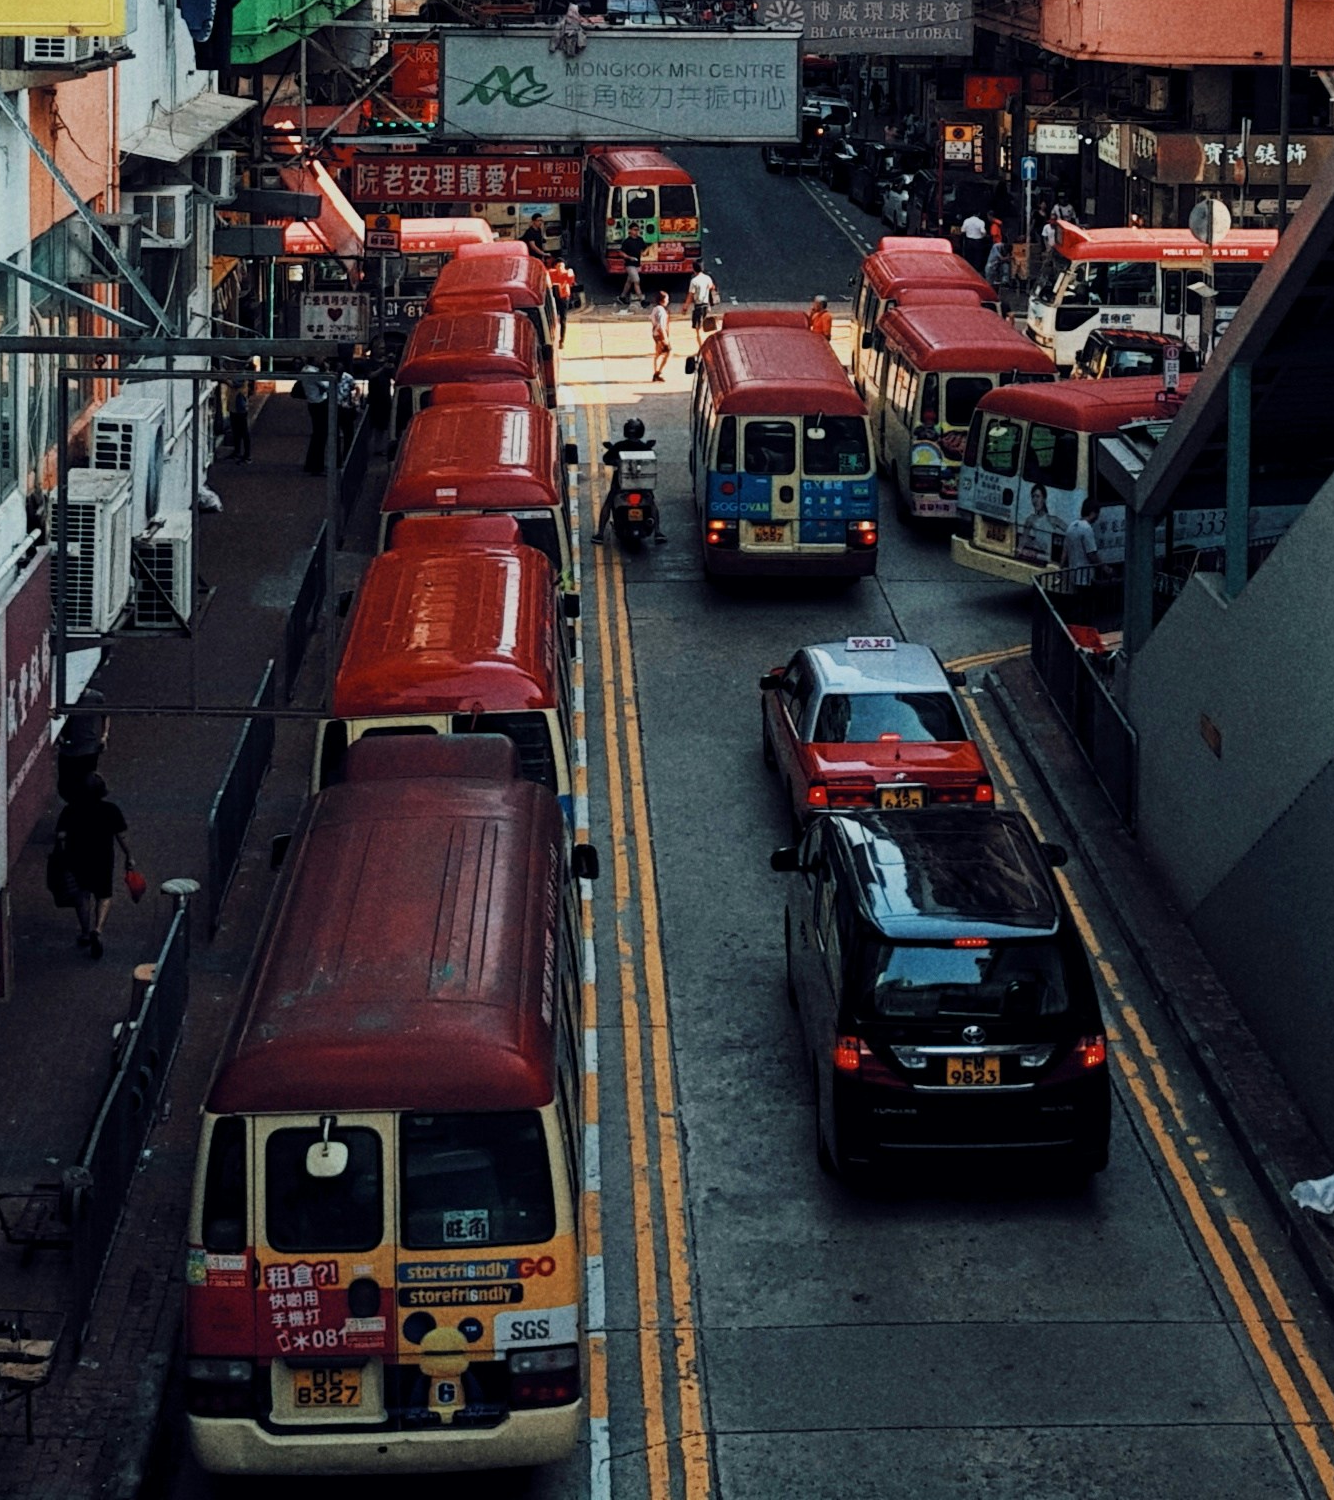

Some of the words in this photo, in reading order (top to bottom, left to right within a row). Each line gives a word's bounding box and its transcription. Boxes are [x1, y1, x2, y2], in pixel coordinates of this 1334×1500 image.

[811, 1, 964, 22] 博威環球投資
[810, 26, 900, 40] BLACKWELL
[904, 26, 964, 41] GLOBAL
[565, 62, 664, 78] MONGKOK
[669, 62, 704, 78] MRI
[709, 63, 786, 79] CENTRE
[564, 84, 787, 111] 旺角磁力共振中心
[710, 501, 770, 513] GOGOVAN
[852, 638, 892, 649] TAXI
[962, 1055, 986, 1070] FM
[951, 1070, 997, 1085] 9823
[446, 1217, 487, 1239] 旺角
[518, 1256, 556, 1279] GO
[271, 1308, 322, 1329] 手機打
[510, 1319, 550, 1341] SGS
[298, 1386, 359, 1404] 8327
